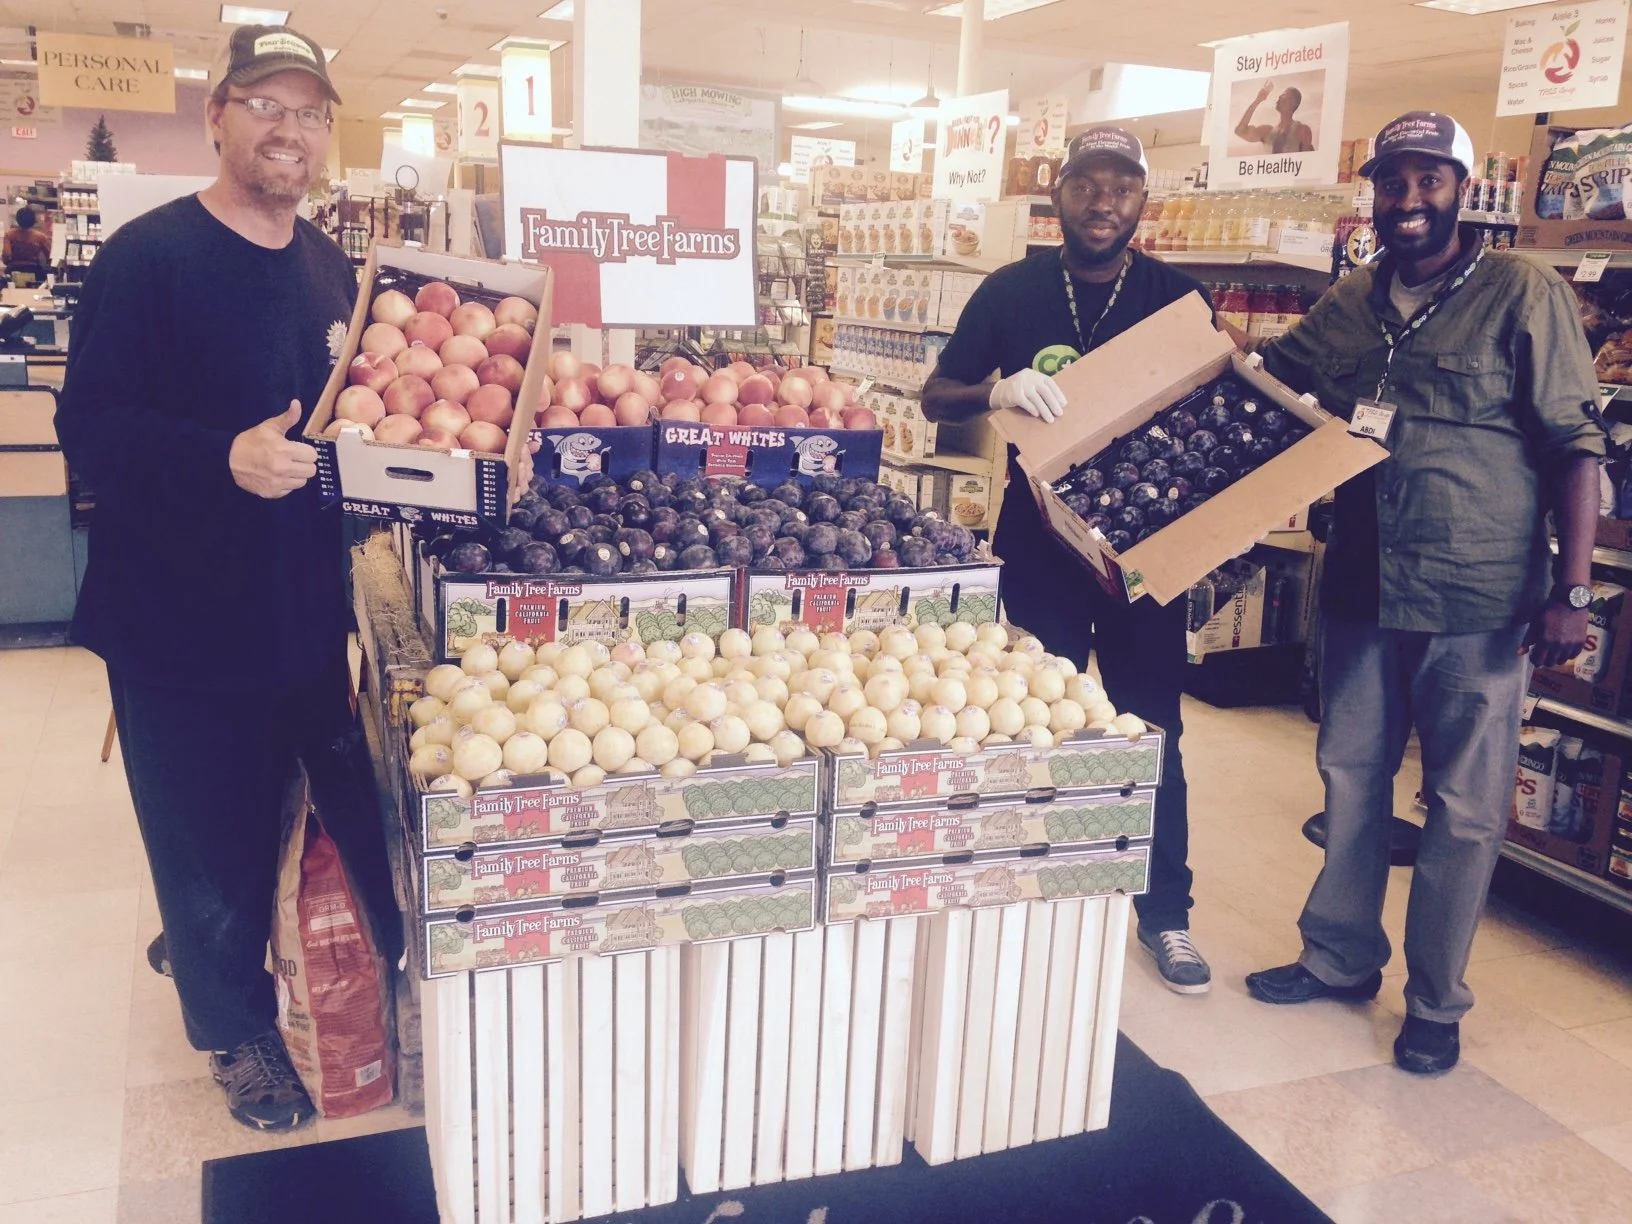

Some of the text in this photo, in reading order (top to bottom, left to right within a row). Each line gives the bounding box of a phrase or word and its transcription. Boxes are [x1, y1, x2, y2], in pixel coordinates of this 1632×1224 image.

[1515, 19, 1536, 28] Baking
[1552, 9, 1579, 21] Aisle 3
[44, 50, 168, 75] PERSONAL
[1236, 44, 1323, 72] Stay Hydrated
[1591, 56, 1612, 64] Sugar
[74, 75, 140, 93] CARE
[525, 75, 536, 116] 1
[670, 88, 697, 99] HIGH
[700, 89, 742, 105] MOWING
[474, 101, 490, 137] 2
[1416, 120, 1436, 129] Farms
[1239, 157, 1303, 177] Be Healthy
[949, 168, 986, 188] Why Not?
[526, 214, 736, 259] Family Tree Farms
[665, 427, 786, 448] GREAT WHITES
[1360, 426, 1376, 435] ABDI
[342, 502, 390, 517] GREAT
[430, 512, 478, 526] WHITES
[488, 581, 580, 598] Family Tree Farms
[788, 573, 868, 588] Family Tree Farms
[1233, 588, 1244, 636] essenti
[877, 757, 963, 777] Family Tree Farms
[473, 794, 580, 816] Family Tree Farms
[873, 815, 960, 834] Family Tree Farms
[474, 853, 579, 878] Family Tree Farms
[566, 866, 593, 874] PREMIUM
[562, 873, 598, 882] CALIFORNIA
[868, 872, 953, 892] Family Tree Farms
[476, 916, 580, 941] Family Tree Farms
